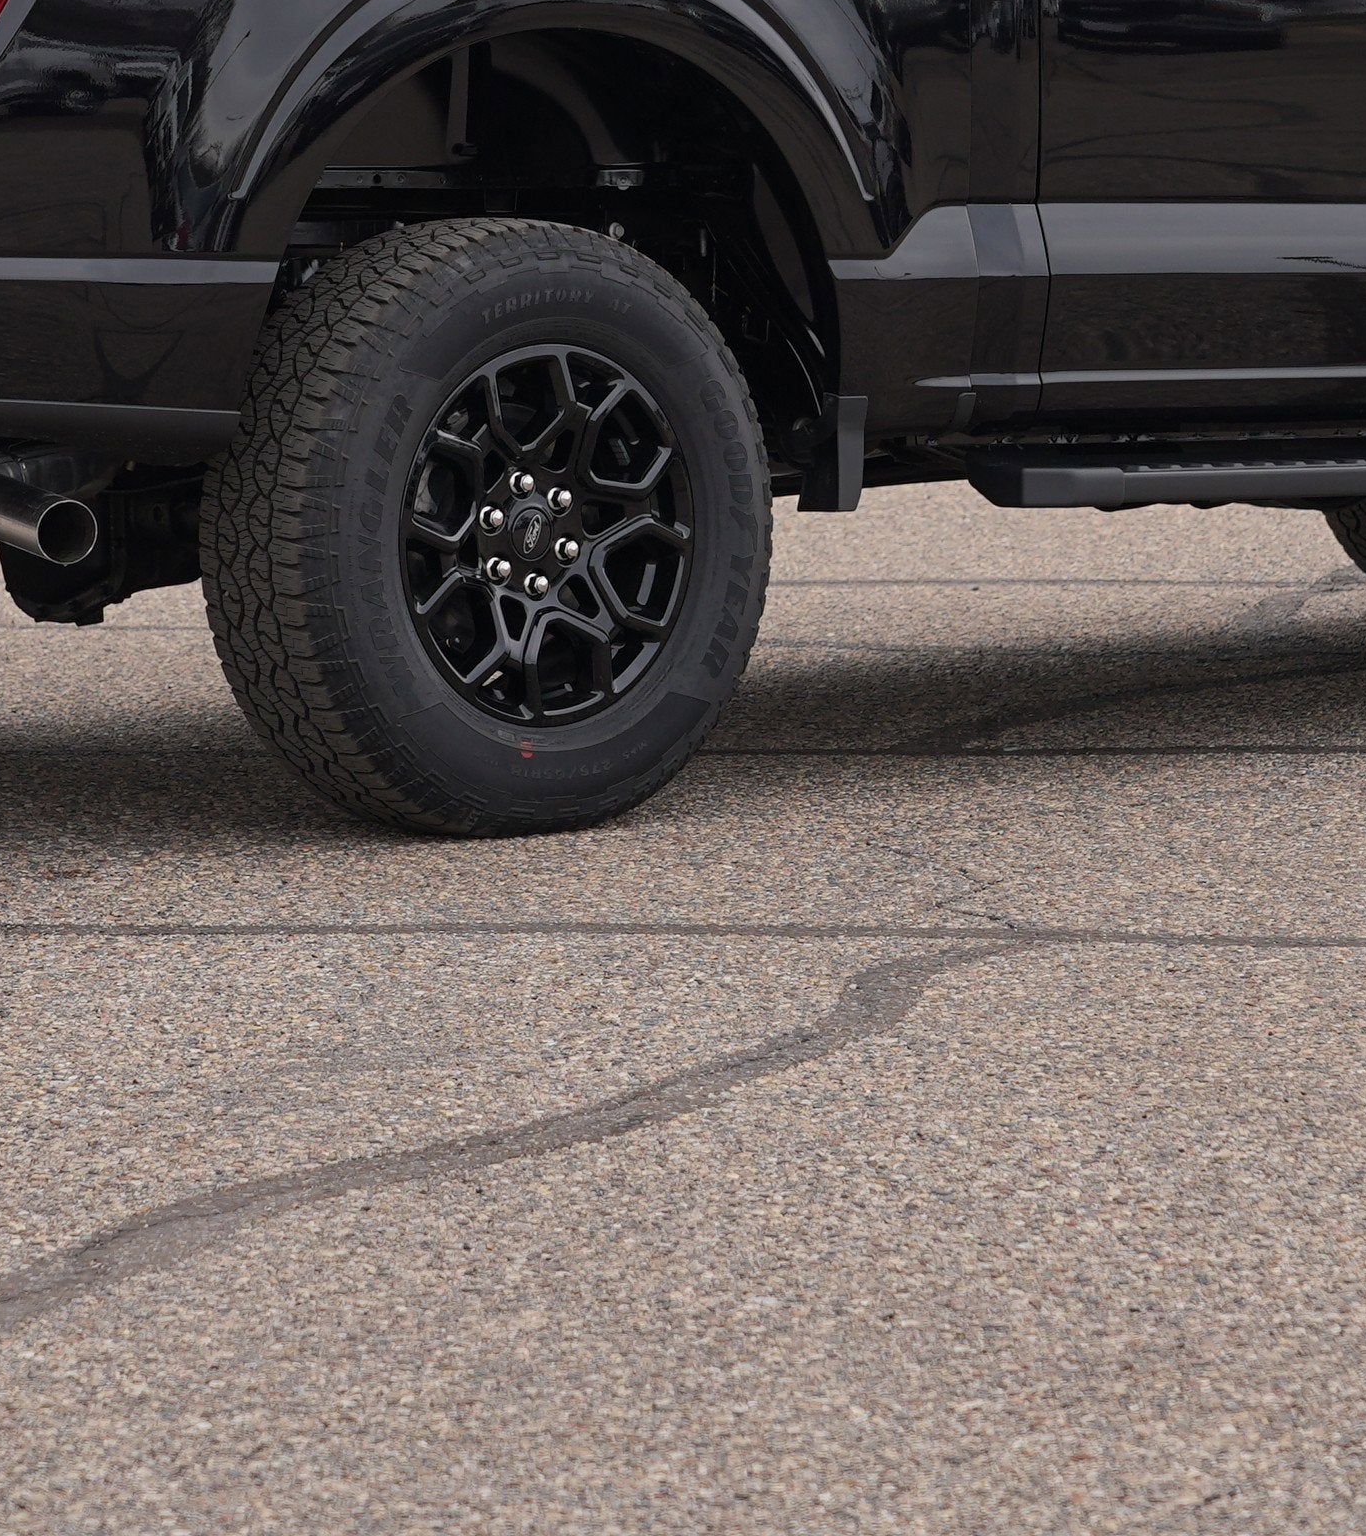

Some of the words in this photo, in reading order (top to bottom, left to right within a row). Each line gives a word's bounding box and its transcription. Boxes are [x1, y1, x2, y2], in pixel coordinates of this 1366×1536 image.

[480, 287, 596, 326] TERRITORY
[361, 393, 417, 697] WRANGLER
[699, 378, 757, 680] GOODYEAR
